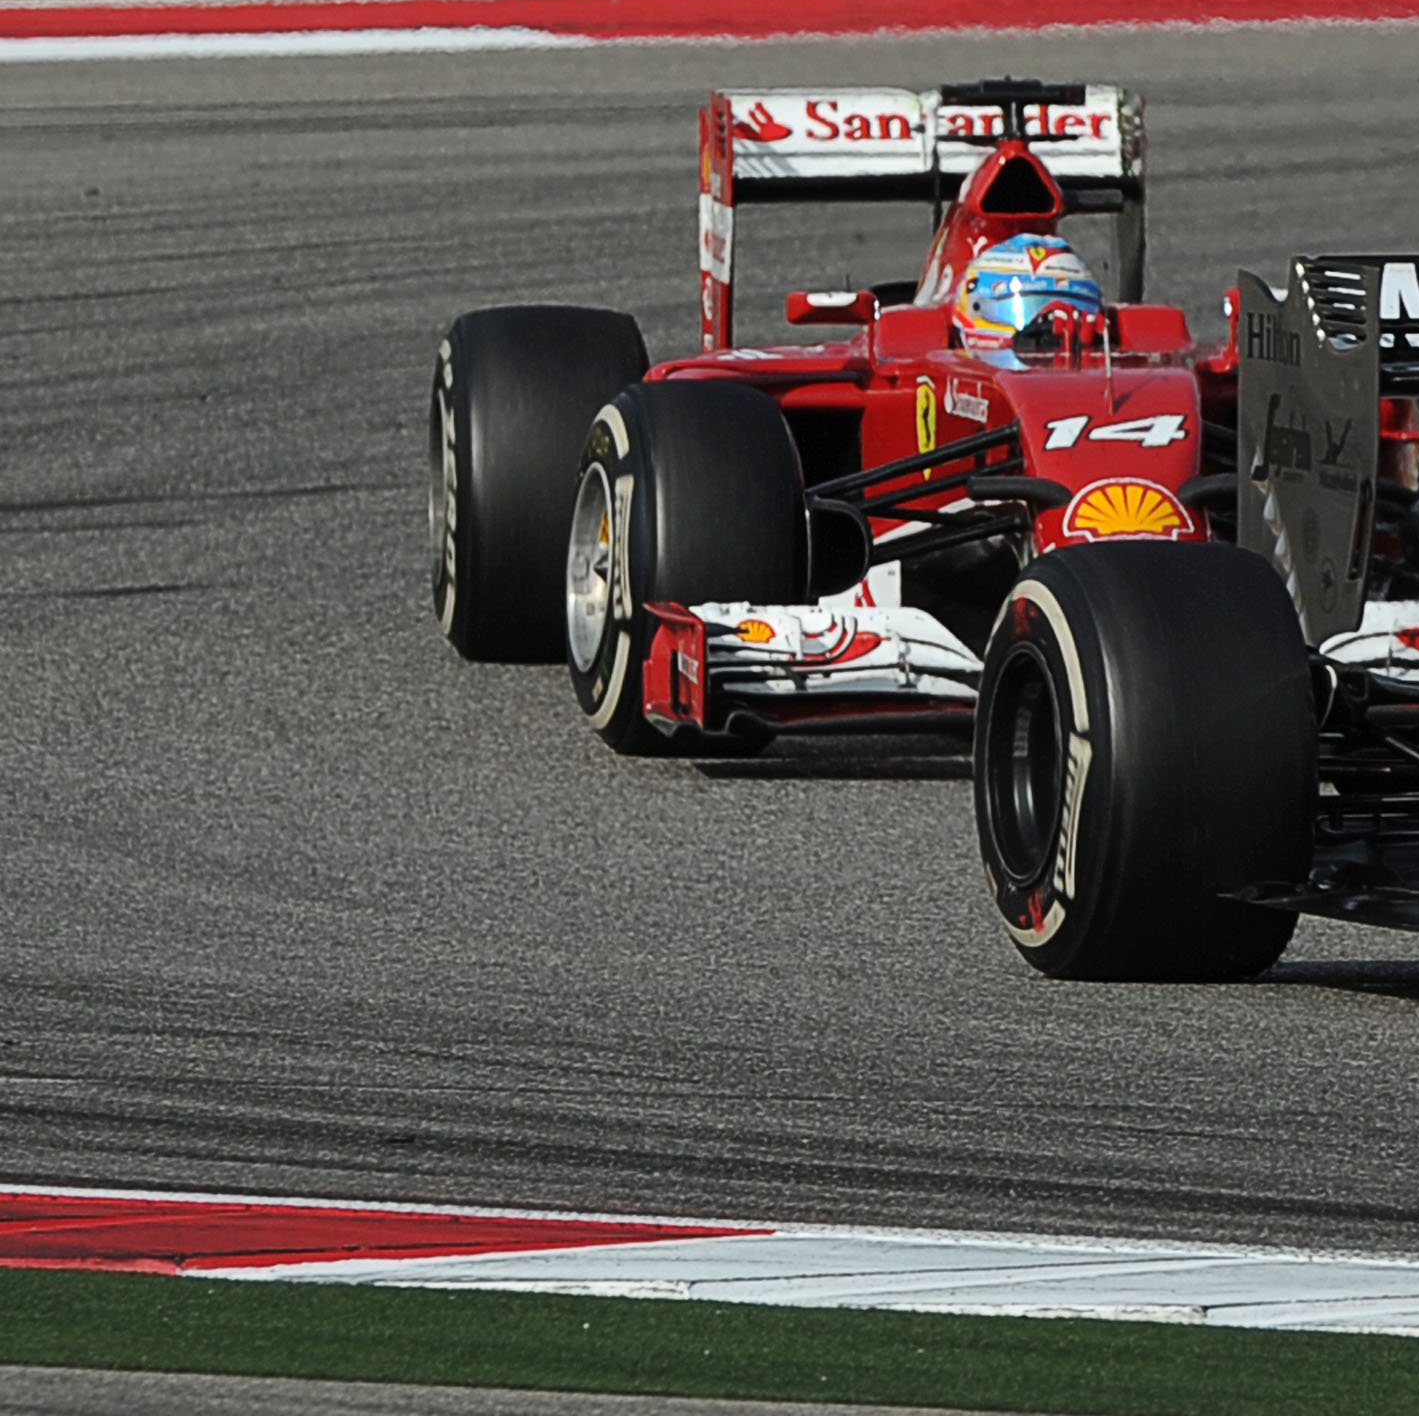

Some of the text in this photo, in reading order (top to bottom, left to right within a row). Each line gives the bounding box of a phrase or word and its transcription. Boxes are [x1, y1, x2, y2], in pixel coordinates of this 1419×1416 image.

[805, 100, 1113, 141] Sanander
[1246, 311, 1301, 369] Hilton
[1045, 414, 1187, 451] 14
